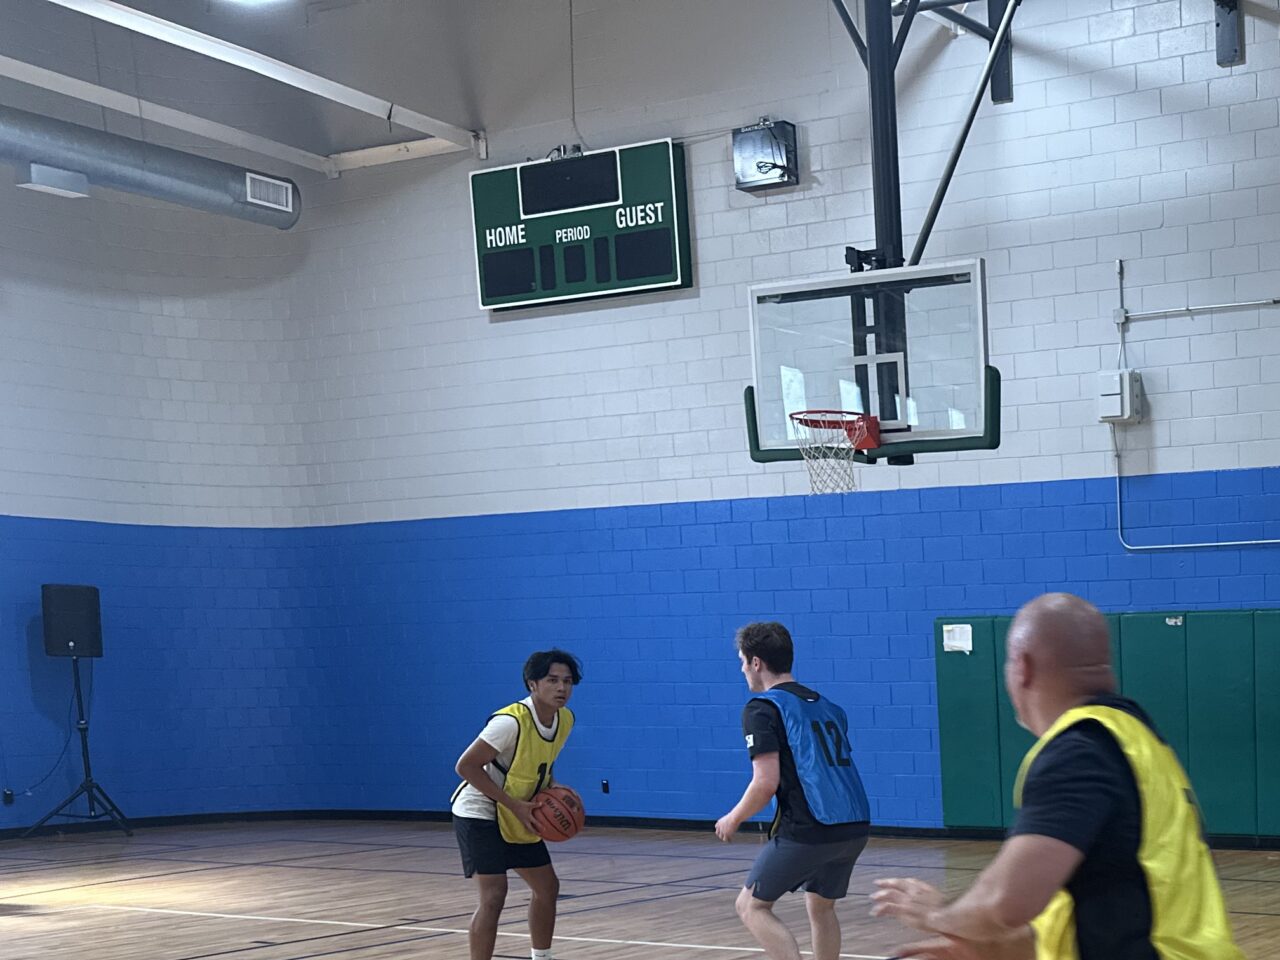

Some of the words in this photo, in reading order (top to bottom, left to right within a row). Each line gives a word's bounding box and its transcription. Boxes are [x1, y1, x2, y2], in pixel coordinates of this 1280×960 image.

[615, 202, 664, 228] GUEST
[485, 224, 527, 248] HOME
[555, 225, 591, 243] PERIOD
[811, 720, 851, 767] 12
